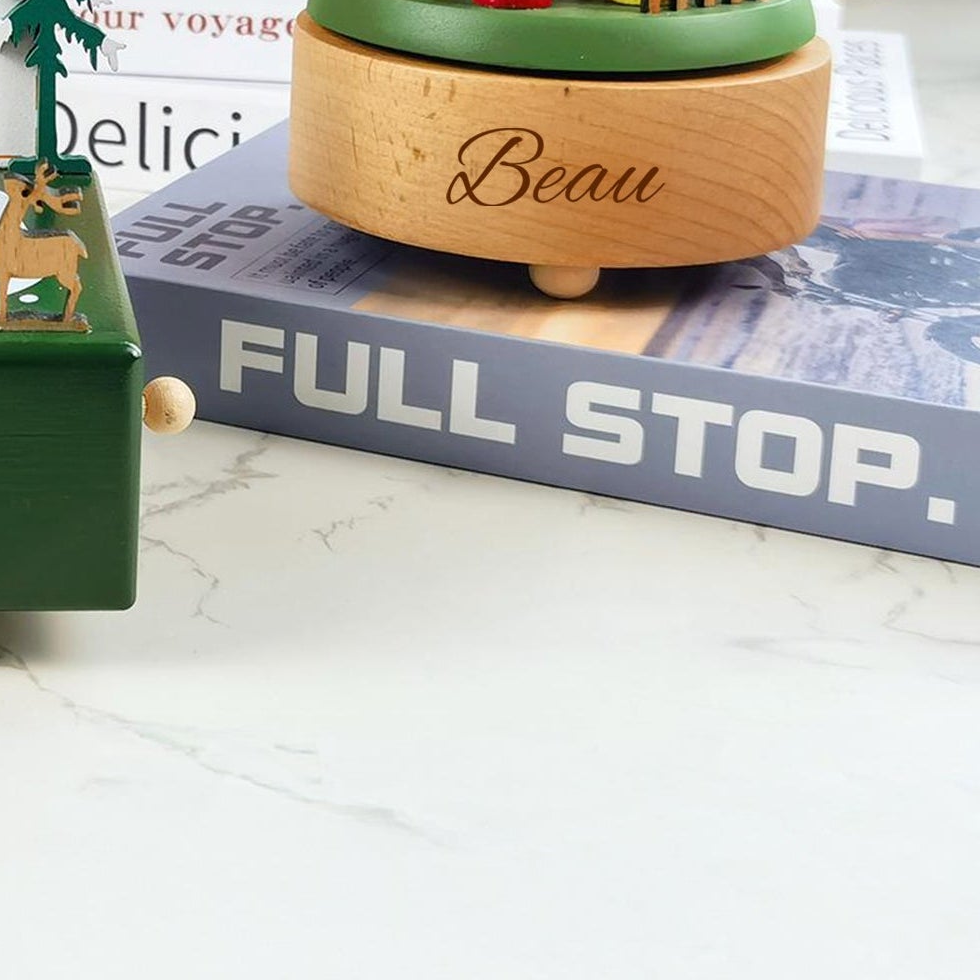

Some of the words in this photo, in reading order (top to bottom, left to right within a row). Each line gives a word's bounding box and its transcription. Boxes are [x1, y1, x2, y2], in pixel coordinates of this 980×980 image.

[446, 127, 665, 208] Beau
[115, 202, 228, 259] FULL
[220, 319, 516, 445] FULL
[561, 380, 956, 525] STOP.
